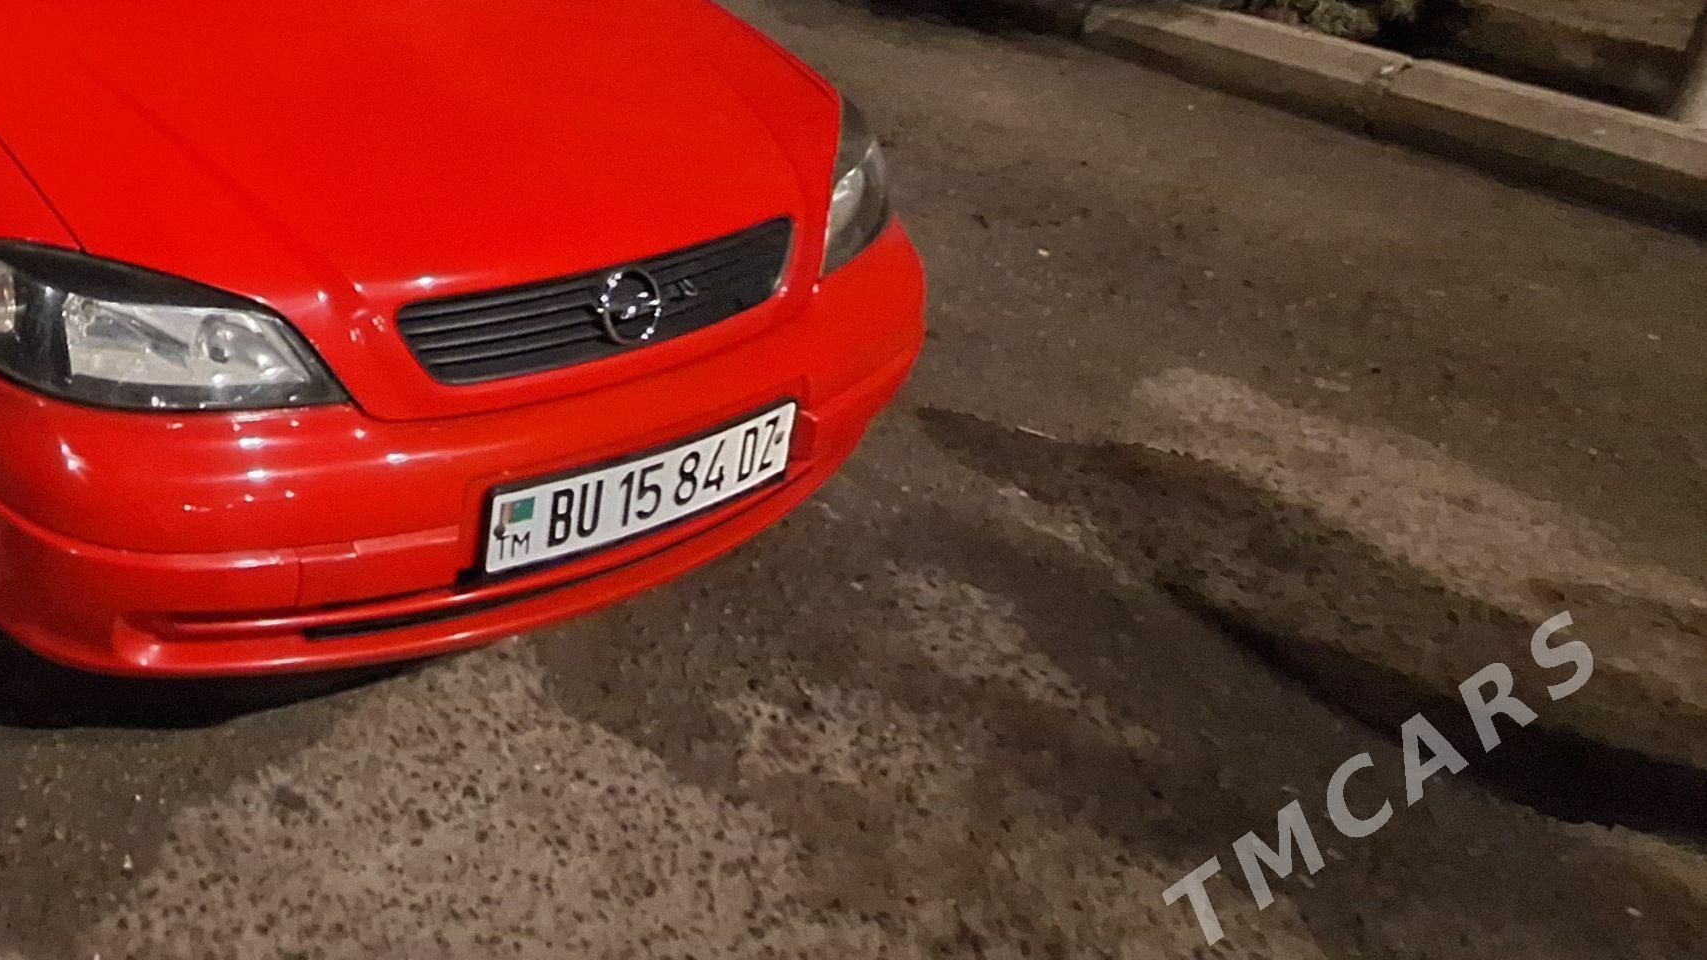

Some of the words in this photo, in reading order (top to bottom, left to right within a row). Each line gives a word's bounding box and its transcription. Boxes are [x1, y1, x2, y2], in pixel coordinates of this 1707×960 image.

[547, 479, 604, 547] BU
[619, 462, 664, 527] 15
[674, 439, 725, 506] 84
[737, 415, 780, 482] DZ
[495, 531, 530, 560] TM
